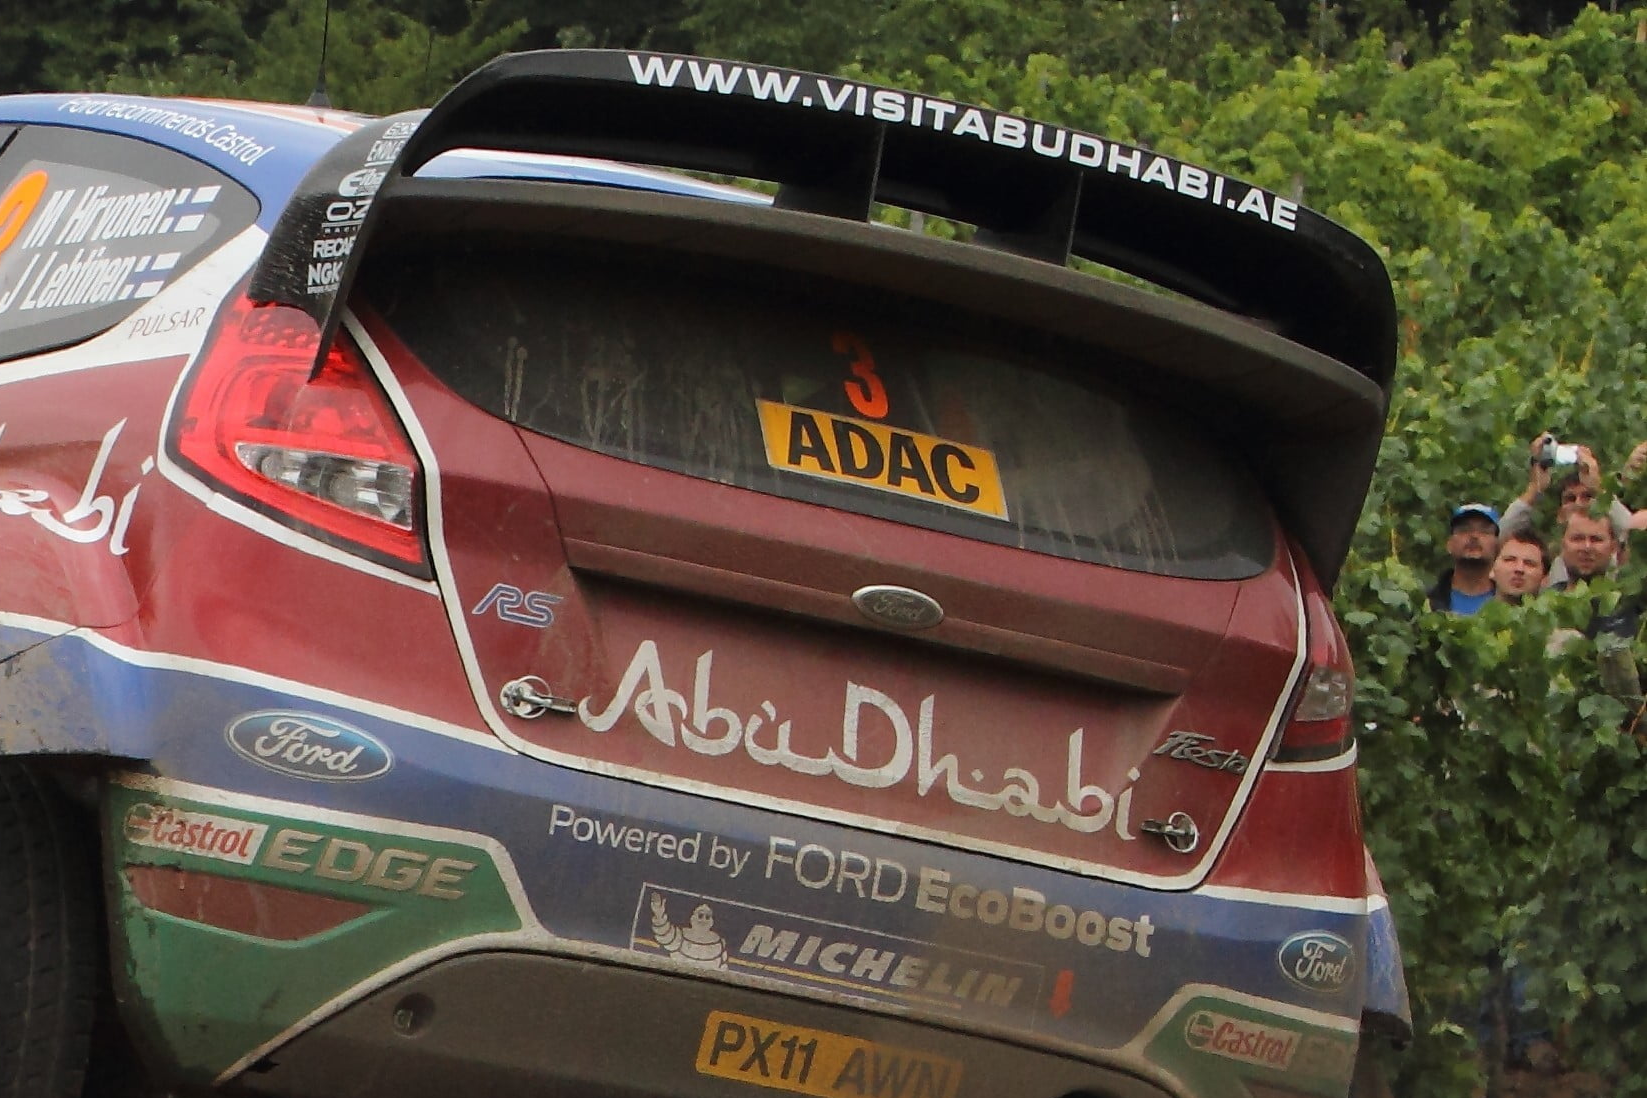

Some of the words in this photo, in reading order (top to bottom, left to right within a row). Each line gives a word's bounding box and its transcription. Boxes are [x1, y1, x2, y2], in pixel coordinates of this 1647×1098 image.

[205, 124, 275, 166] Castrol
[627, 54, 1300, 232] WWW.VISITABUDHABI.AE
[22, 189, 76, 249] M
[55, 185, 177, 246] Hirvonen
[19, 247, 137, 311] Lehtinen
[307, 261, 343, 286] NGK
[128, 306, 205, 340] PULSAR
[831, 332, 891, 420] 3
[787, 411, 981, 507] ADAC
[472, 583, 564, 628] RS
[254, 716, 365, 777] Ford
[1153, 730, 1251, 775] Fiesta
[152, 808, 256, 858] Castrol
[260, 828, 481, 900] EDGE
[549, 804, 701, 867] Powered
[708, 833, 750, 879] by
[765, 837, 909, 904] FORD
[915, 869, 1156, 960] EcoBoost
[739, 924, 1024, 1009] MICHELIN
[709, 1021, 819, 1086] PX11
[1212, 1021, 1296, 1065] Castrol
